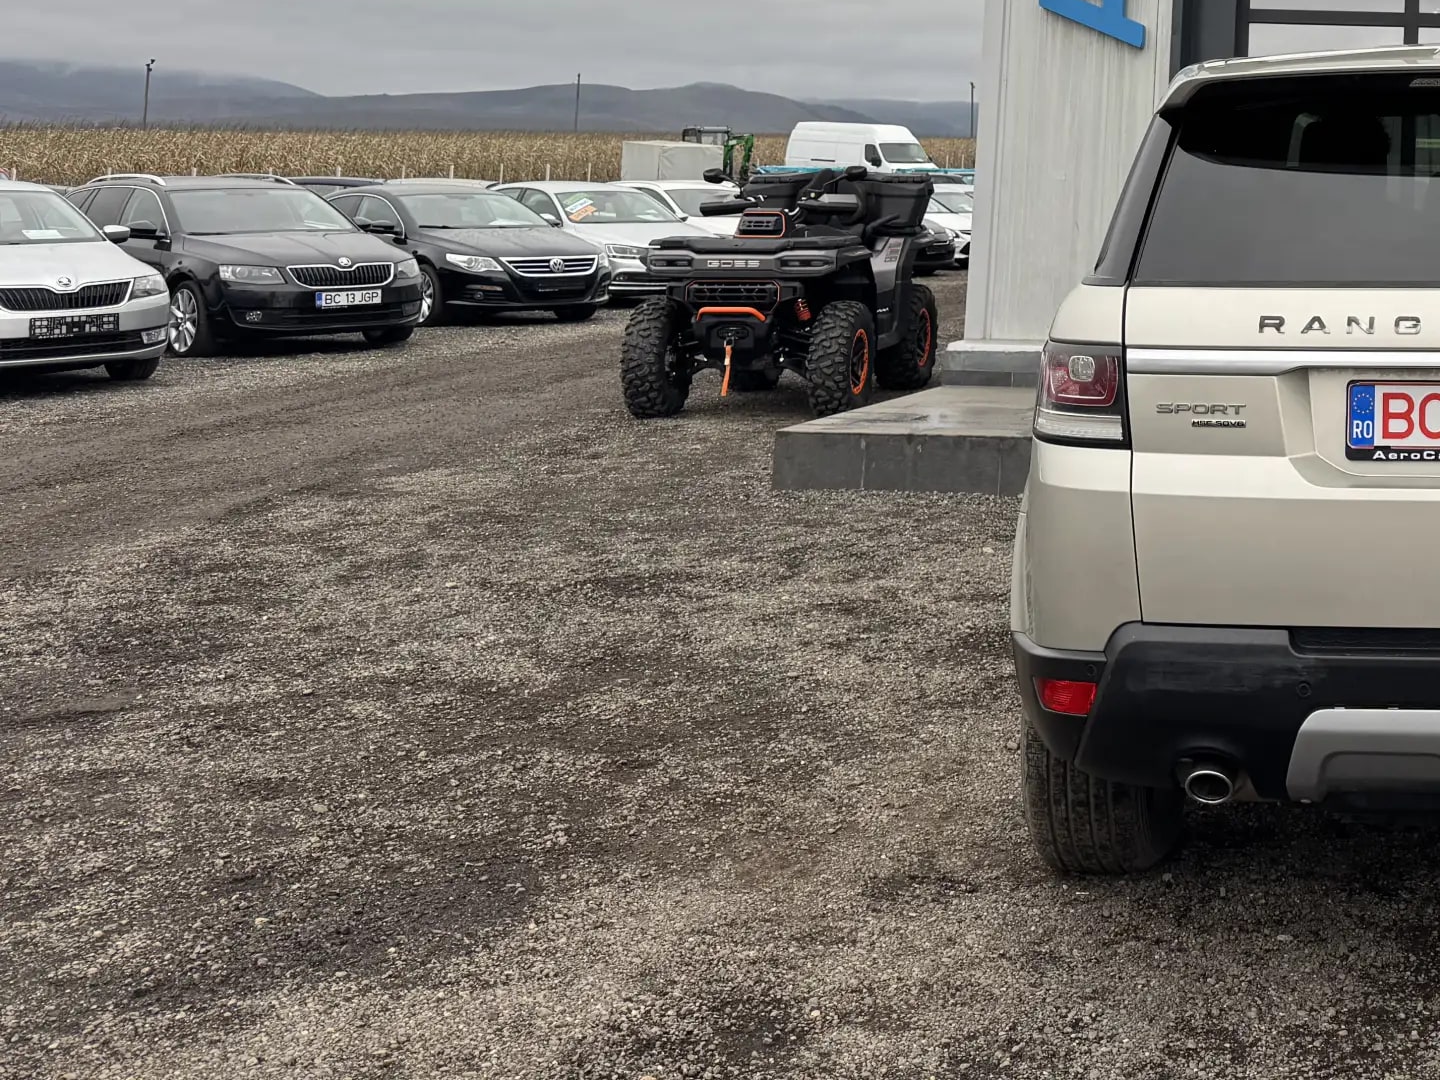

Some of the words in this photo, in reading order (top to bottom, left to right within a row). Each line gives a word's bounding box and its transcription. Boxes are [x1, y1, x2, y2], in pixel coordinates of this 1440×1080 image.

[707, 260, 760, 268] GOES
[324, 293, 341, 305] BC
[345, 293, 356, 304] 13
[358, 291, 379, 303] JGP
[1156, 402, 1247, 415] SPORT
[1352, 420, 1373, 438] RO
